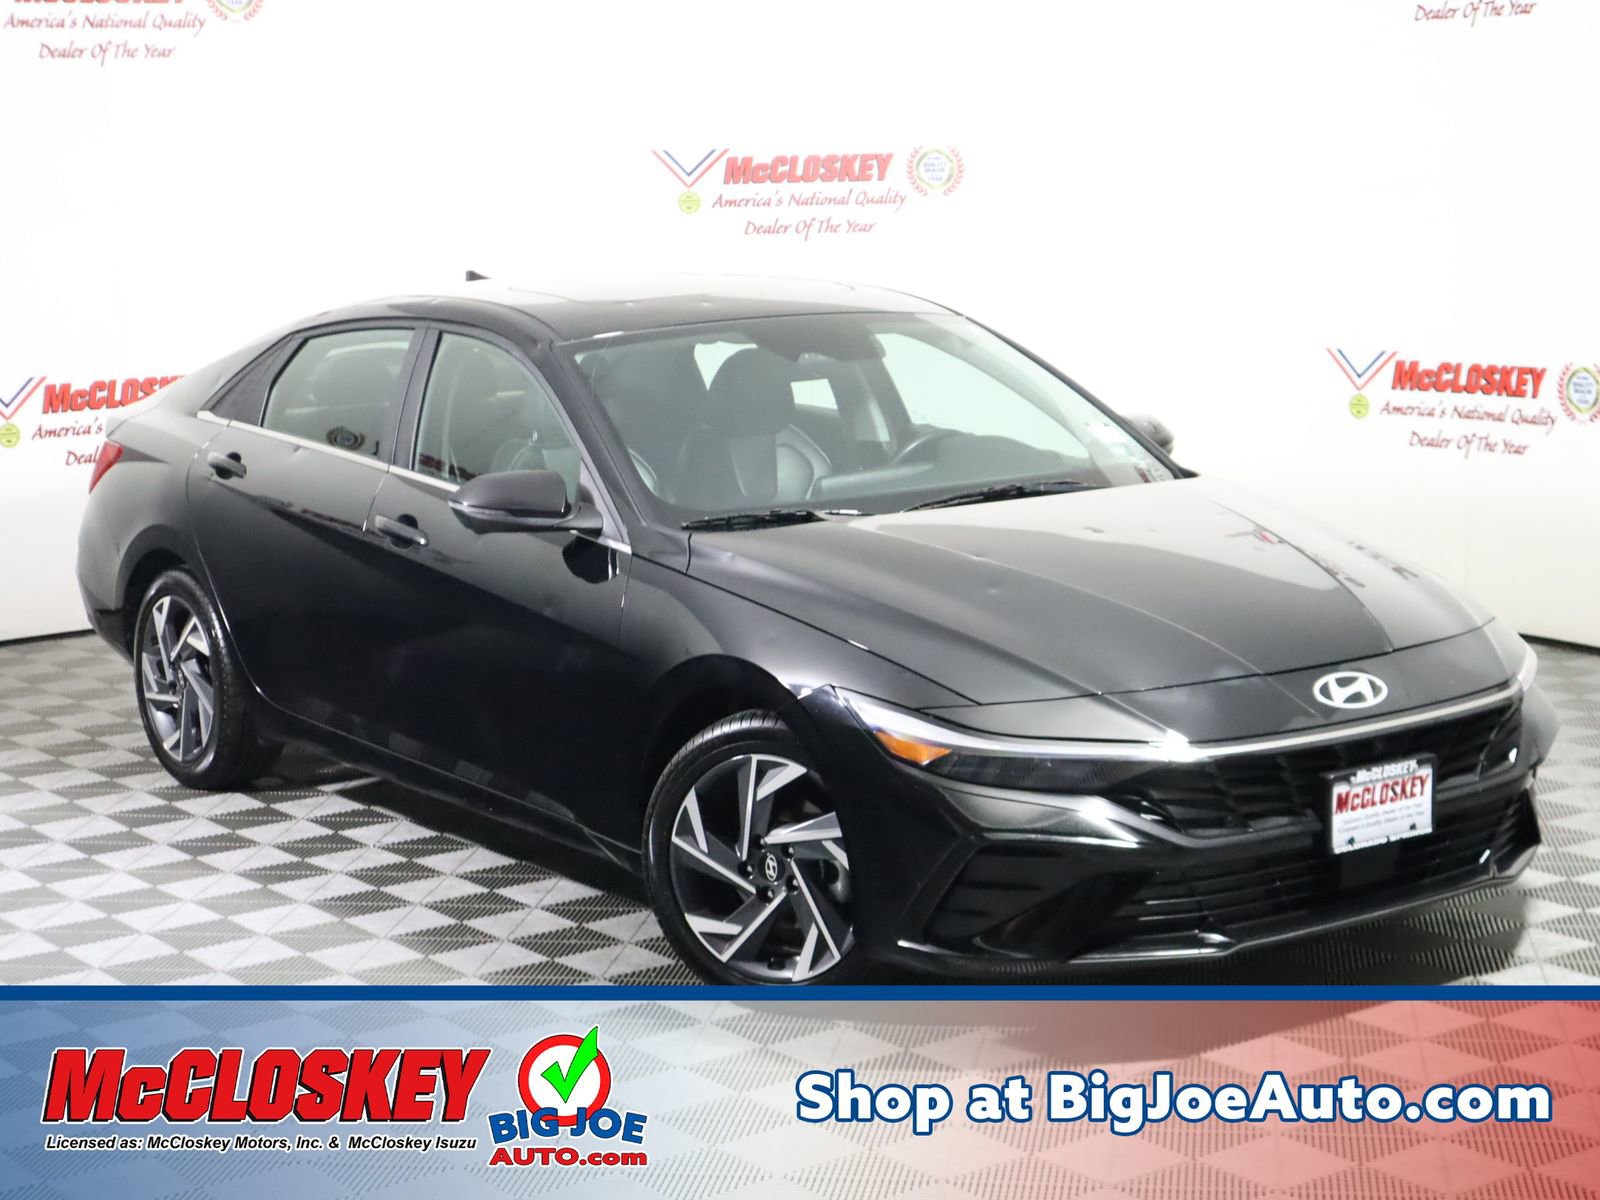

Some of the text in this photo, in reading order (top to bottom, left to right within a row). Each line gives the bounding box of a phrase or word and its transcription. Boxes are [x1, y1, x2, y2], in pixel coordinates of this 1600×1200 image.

[3, 10, 206, 37] America's National Quality
[1414, 0, 1536, 27] Dealer Of The Year
[38, 40, 175, 67] Dealer Of The Year
[723, 153, 894, 185] McCLOSKEY
[712, 190, 783, 209] America's
[787, 188, 850, 208] National
[855, 187, 907, 212] Quality
[744, 217, 876, 242] Dealer Of The Year
[1391, 360, 1547, 399] McCLOSKEY
[43, 375, 186, 414] McCLOS
[32, 416, 103, 440] America's
[1379, 400, 1447, 419] America's
[1450, 404, 1506, 424] National
[1511, 407, 1557, 435] Quality
[65, 445, 99, 466] Deal
[1409, 430, 1530, 459] Dealer Of The Year
[1335, 774, 1429, 815] McCLOSKEY
